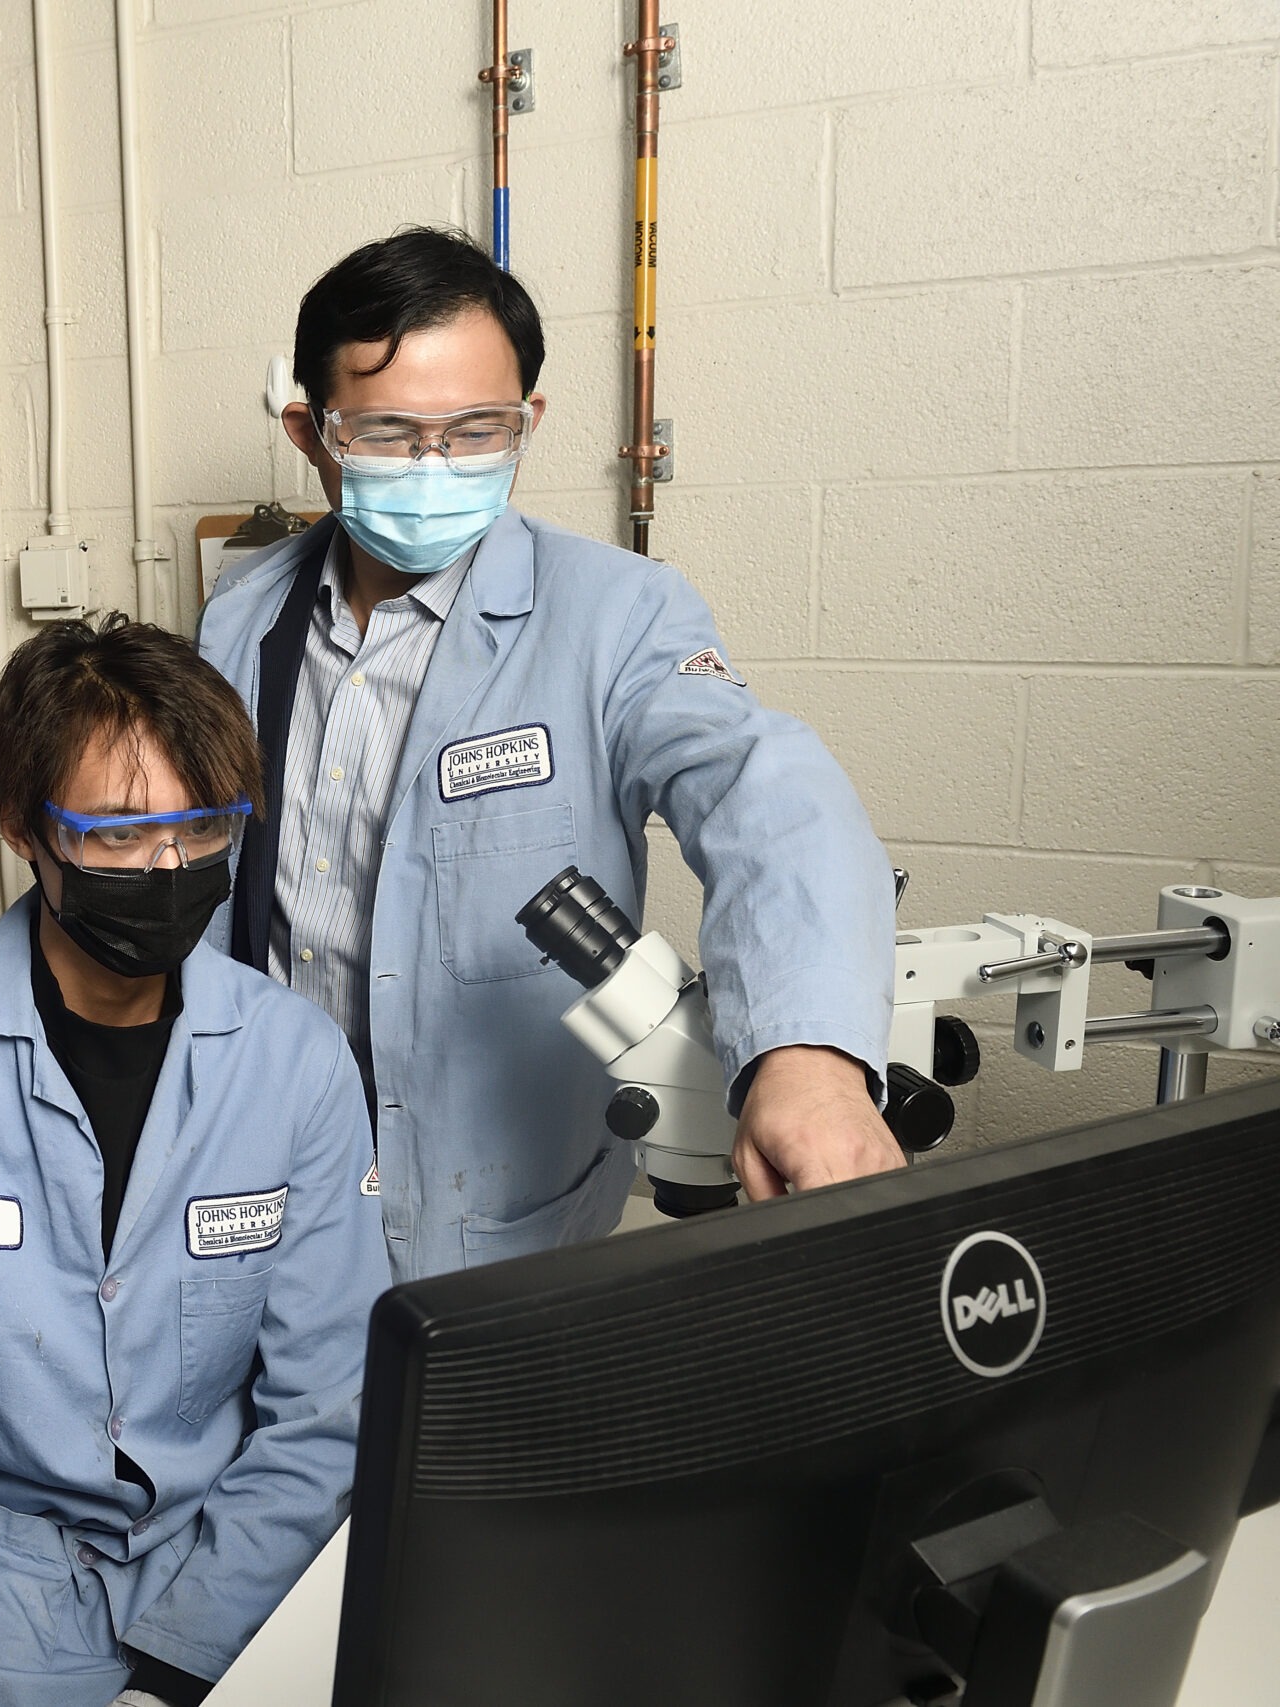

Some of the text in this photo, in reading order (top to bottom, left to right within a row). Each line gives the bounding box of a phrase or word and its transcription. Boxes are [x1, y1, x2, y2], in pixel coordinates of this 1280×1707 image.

[634, 221, 644, 268] VACUUM
[648, 221, 657, 268] VACUUM
[447, 738, 539, 772] JOHNS HOPKINS
[449, 753, 540, 778] UNIVERSITY
[196, 1208, 237, 1228] JOHNS
[952, 1278, 1036, 1332] DELL
